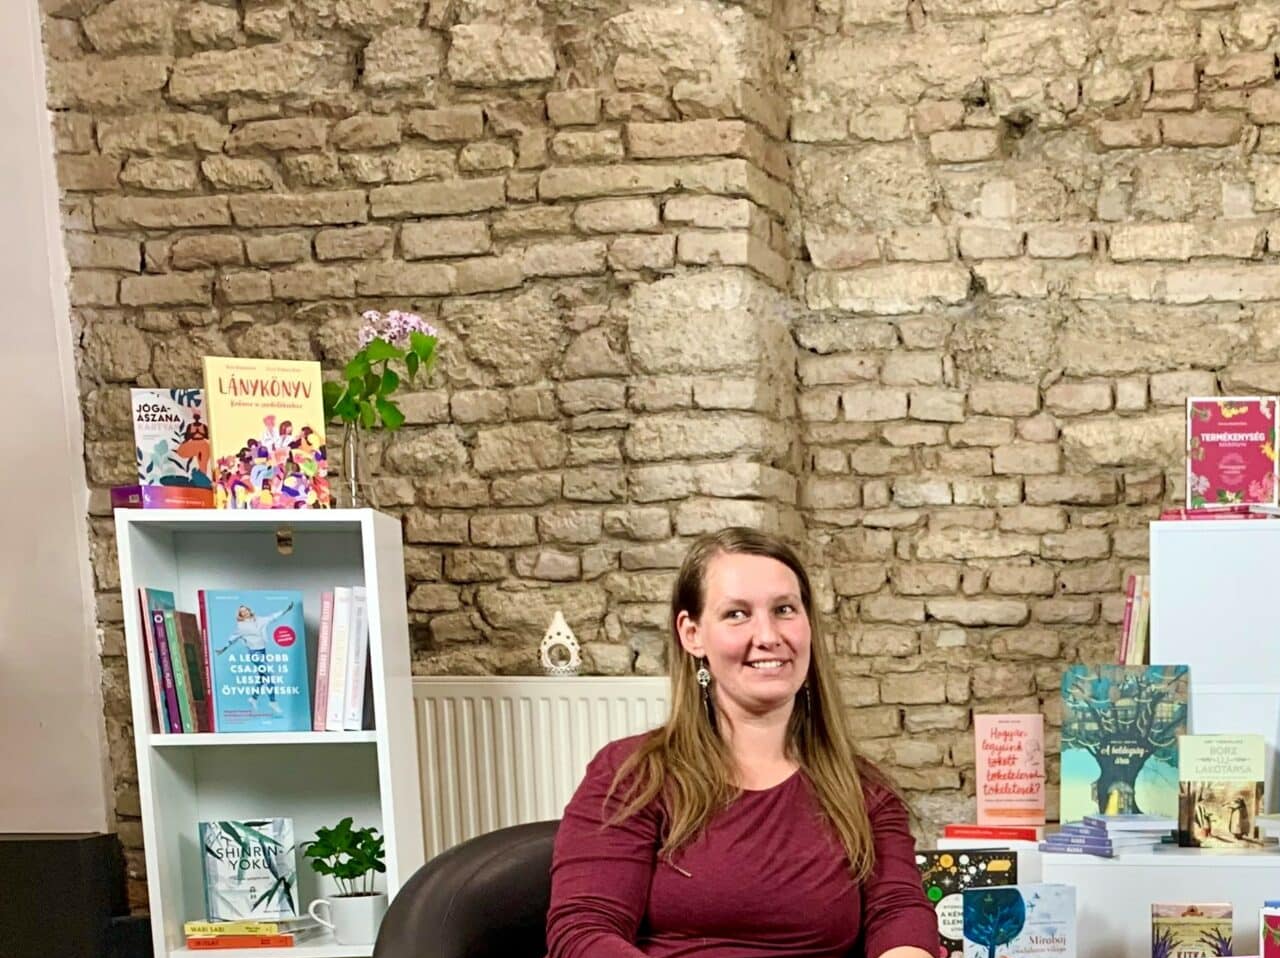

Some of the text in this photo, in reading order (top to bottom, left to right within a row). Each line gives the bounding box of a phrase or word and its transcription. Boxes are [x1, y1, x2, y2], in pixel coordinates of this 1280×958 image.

[219, 373, 312, 398] LÁNYKÖNYV
[136, 403, 171, 412] JÓGA-
[137, 414, 181, 422] ASZANA
[1201, 431, 1265, 442] TERMÉKENYSÉG
[229, 654, 288, 662] A LEGJOBB
[230, 665, 288, 673] CSAJOK IS
[236, 675, 284, 684] LESZNEK
[222, 685, 300, 695] ÖTVENÉVESEK
[229, 859, 271, 870] YOKU
